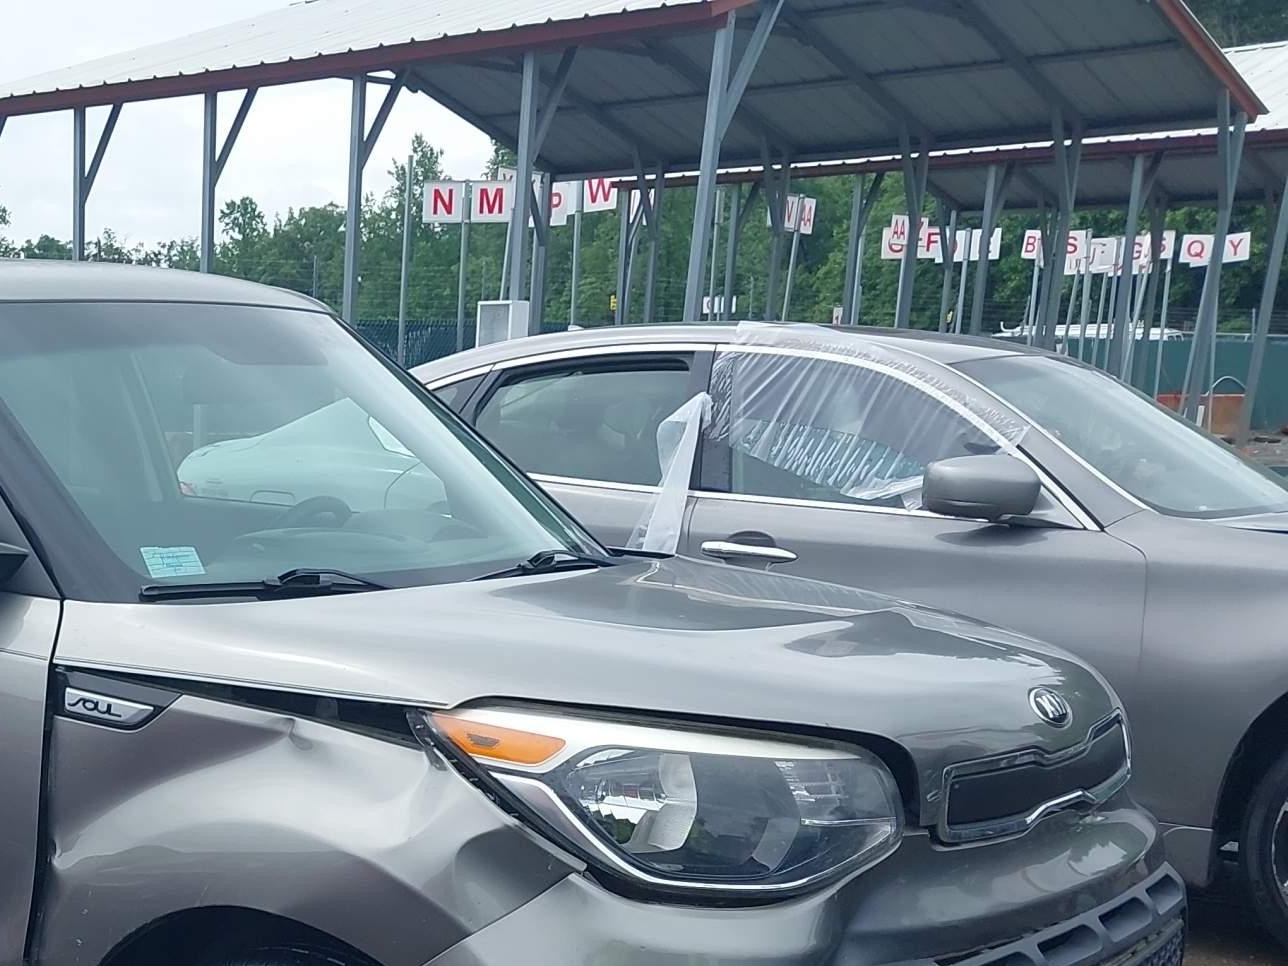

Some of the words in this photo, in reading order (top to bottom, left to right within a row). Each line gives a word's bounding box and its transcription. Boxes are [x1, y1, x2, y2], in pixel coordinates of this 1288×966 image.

[586, 177, 614, 204] W
[432, 188, 454, 215] N
[478, 187, 504, 215] M
[892, 219, 906, 241] AA
[926, 232, 941, 252] F
[1024, 236, 1037, 253] B
[1067, 236, 1078, 254] S
[1187, 240, 1205, 259] Q
[1229, 238, 1245, 257] Y
